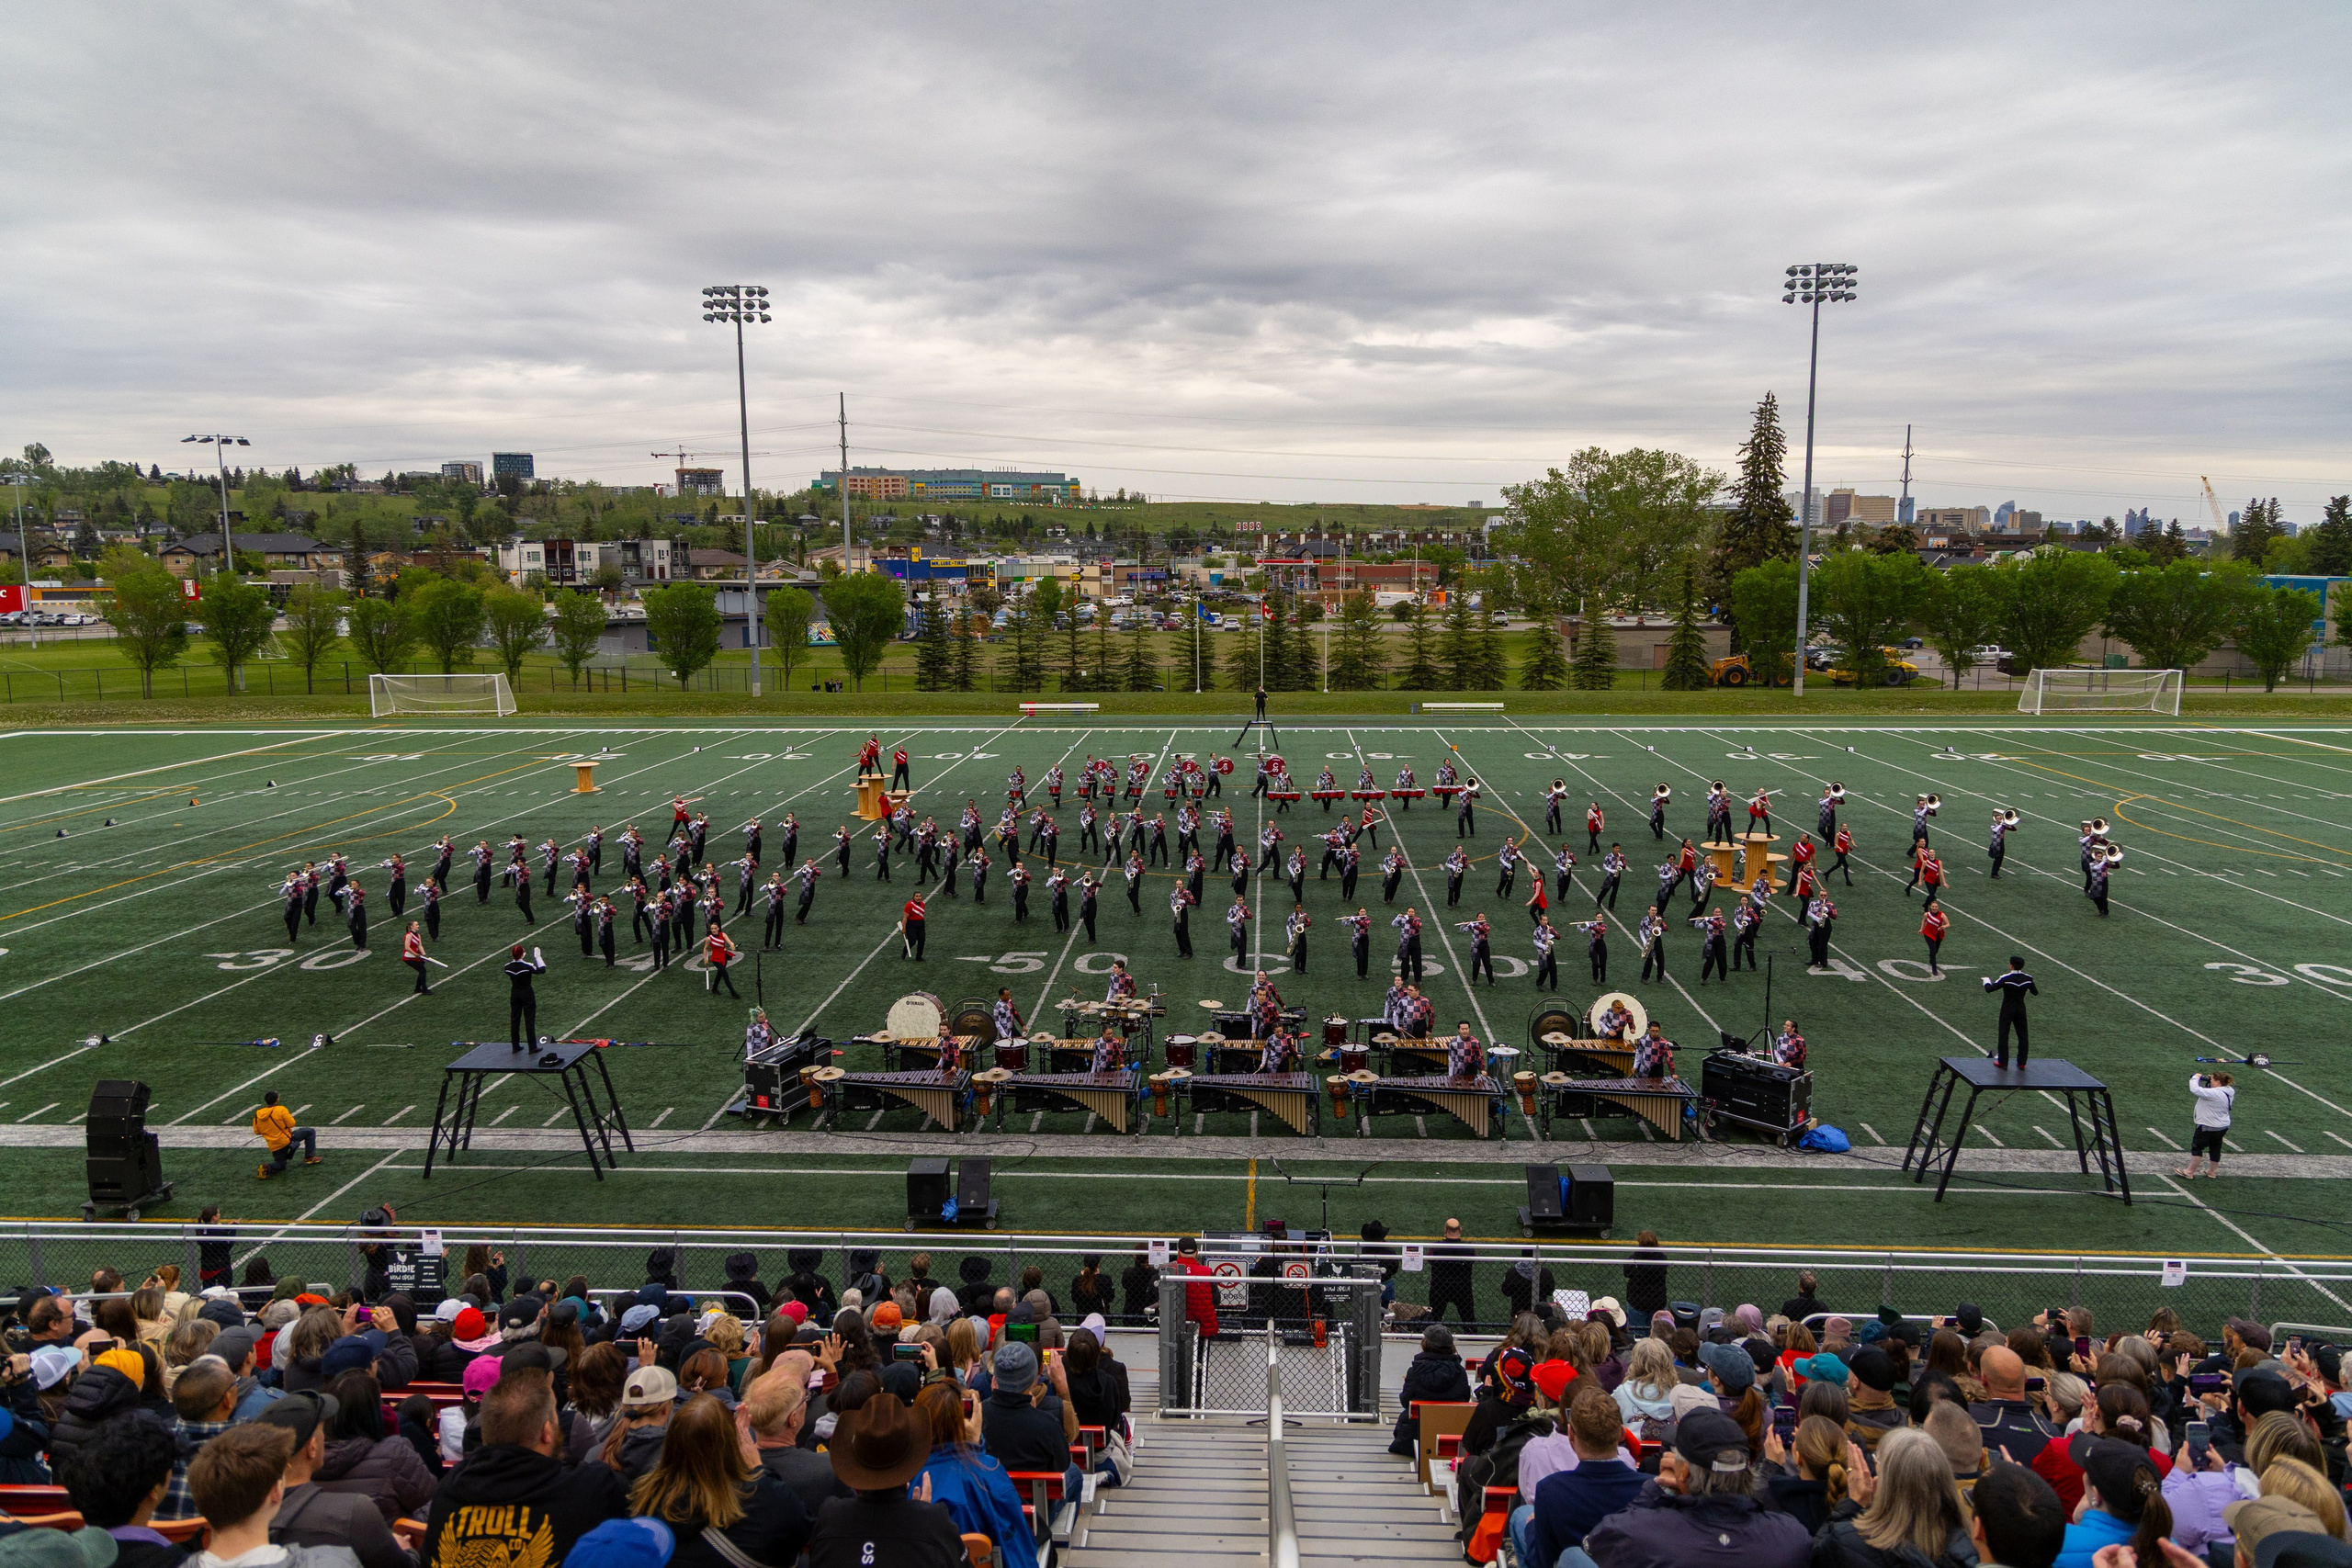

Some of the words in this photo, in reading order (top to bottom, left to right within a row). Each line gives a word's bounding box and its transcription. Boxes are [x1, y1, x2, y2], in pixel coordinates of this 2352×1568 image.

[1237, 522, 1261, 531] ESSO
[218, 948, 372, 970] 30
[989, 952, 1128, 974] 50
[1222, 953, 1291, 976] C
[1805, 958, 1946, 982] 40
[456, 1505, 533, 1540] TROLL
[508, 1538, 523, 1551] CO
